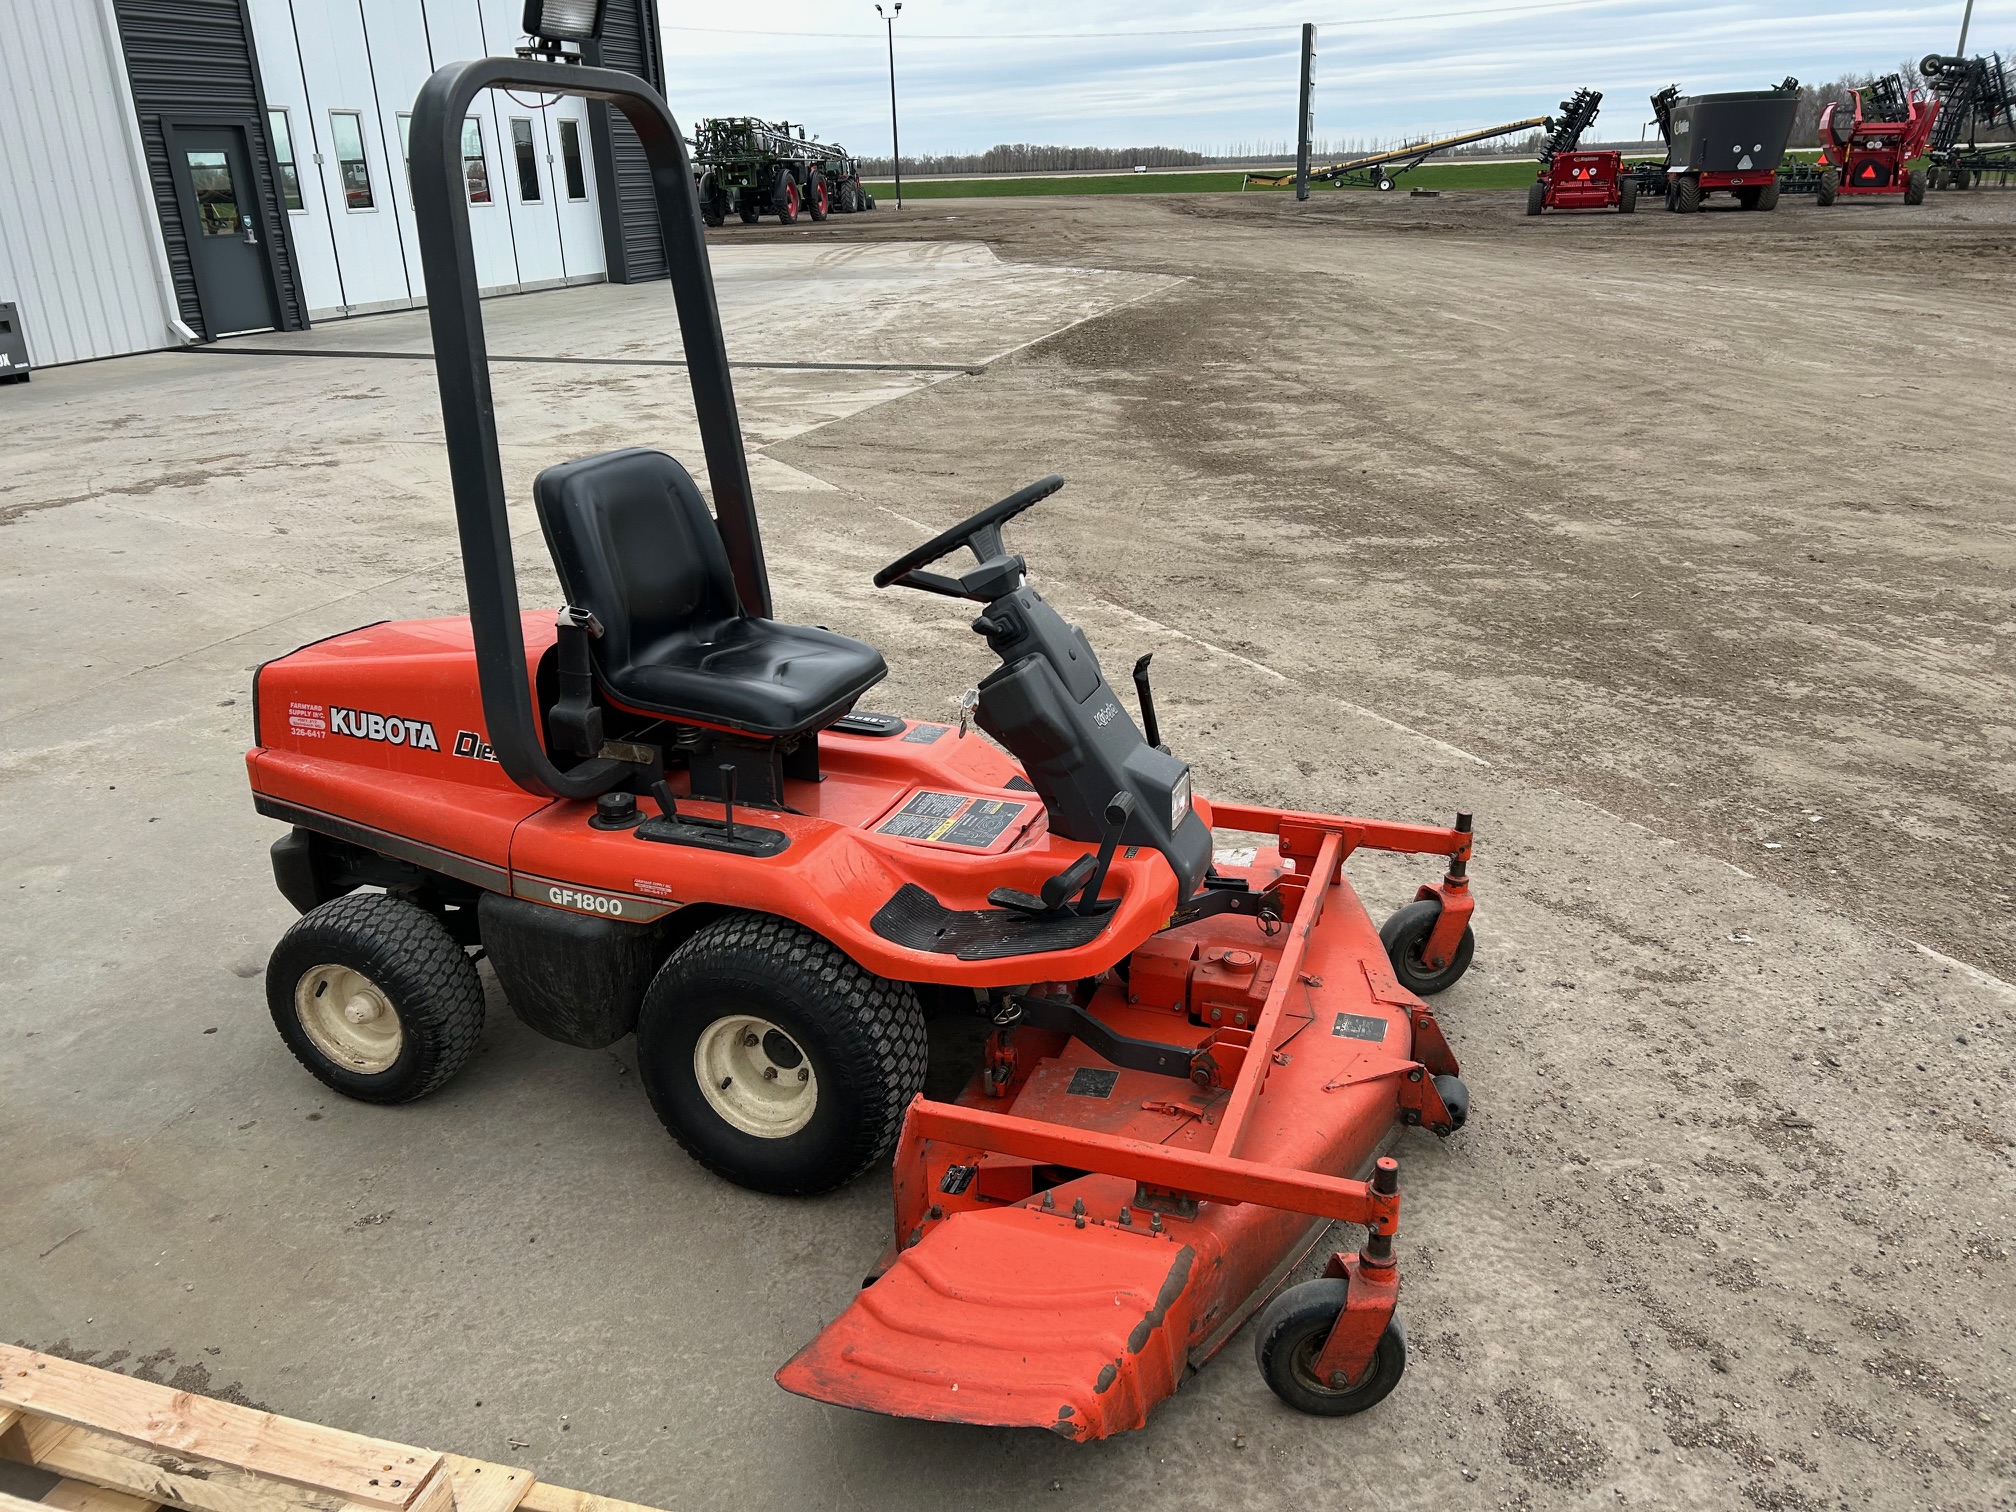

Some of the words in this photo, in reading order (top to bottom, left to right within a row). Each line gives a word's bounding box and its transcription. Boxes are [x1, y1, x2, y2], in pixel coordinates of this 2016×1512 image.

[290, 702, 323, 711] FARMYARD
[288, 709, 312, 717] SUPPLY
[290, 727, 326, 739] 326-6417
[330, 706, 439, 751] KUBOTA
[549, 887, 623, 915] GF1800
